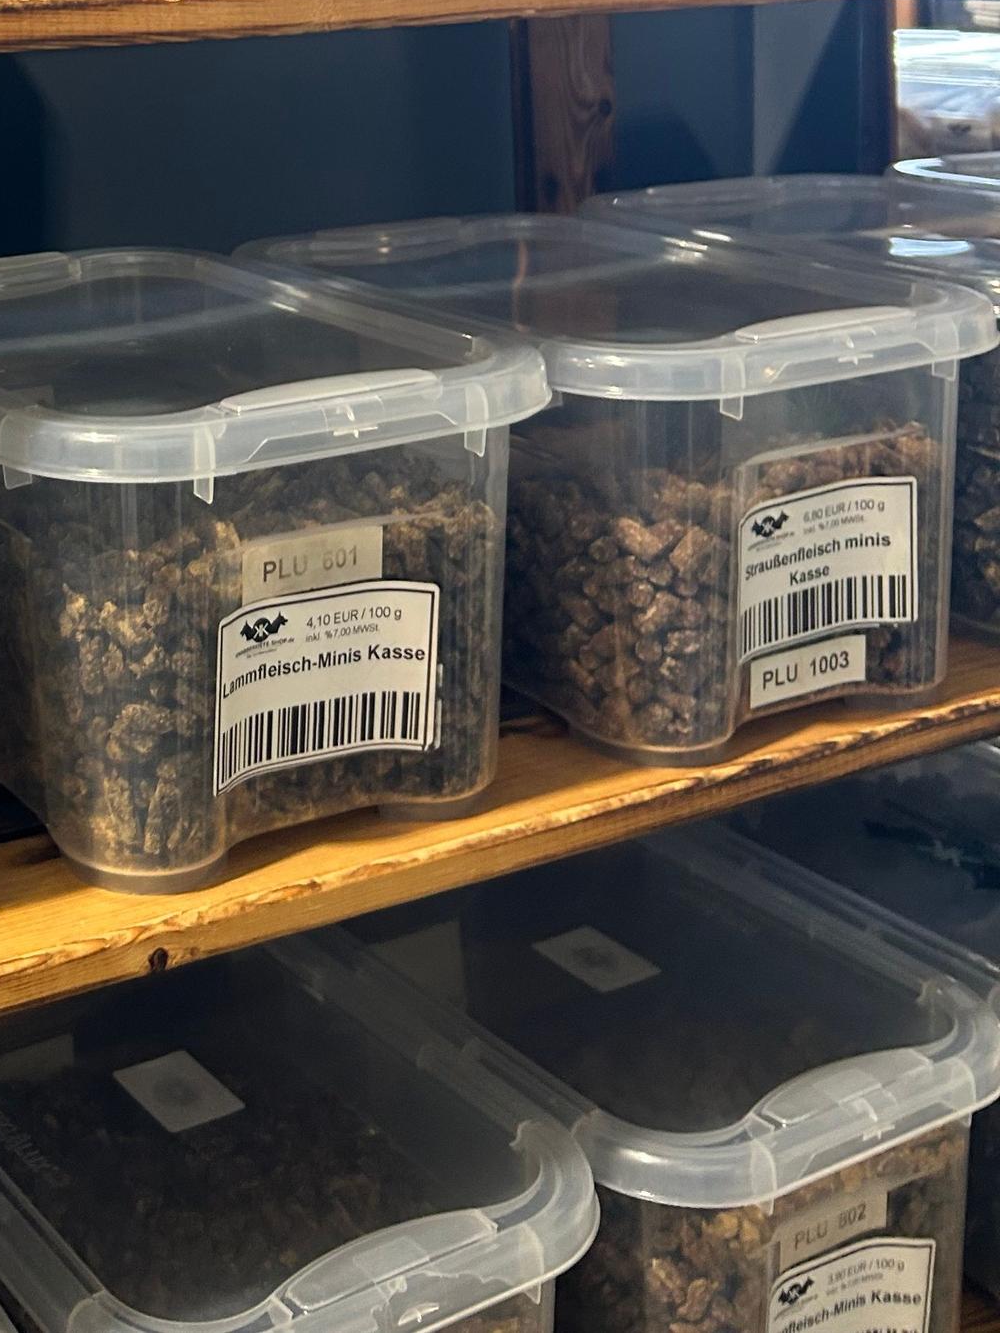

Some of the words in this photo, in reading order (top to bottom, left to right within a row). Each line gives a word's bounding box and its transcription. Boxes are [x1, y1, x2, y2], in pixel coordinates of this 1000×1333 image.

[825, 503, 846, 518] EUR
[854, 499, 875, 510] 100
[877, 501, 885, 512] g
[263, 554, 308, 583] PLU
[322, 545, 357, 571] 601
[745, 539, 841, 581] Straußenfleisch
[845, 532, 891, 547] minis
[789, 565, 830, 586] Kasse
[306, 614, 331, 629] 4,10
[334, 609, 359, 624] EUR
[369, 606, 391, 618] 100
[394, 609, 402, 621] g
[222, 647, 361, 699] Lammfleisch-Minis
[367, 644, 425, 661] Kasse
[763, 663, 798, 690] PLU
[810, 651, 850, 677] 1003
[794, 1220, 828, 1251] PLU
[876, 1258, 895, 1269] 100
[871, 1290, 922, 1305] Kasse
